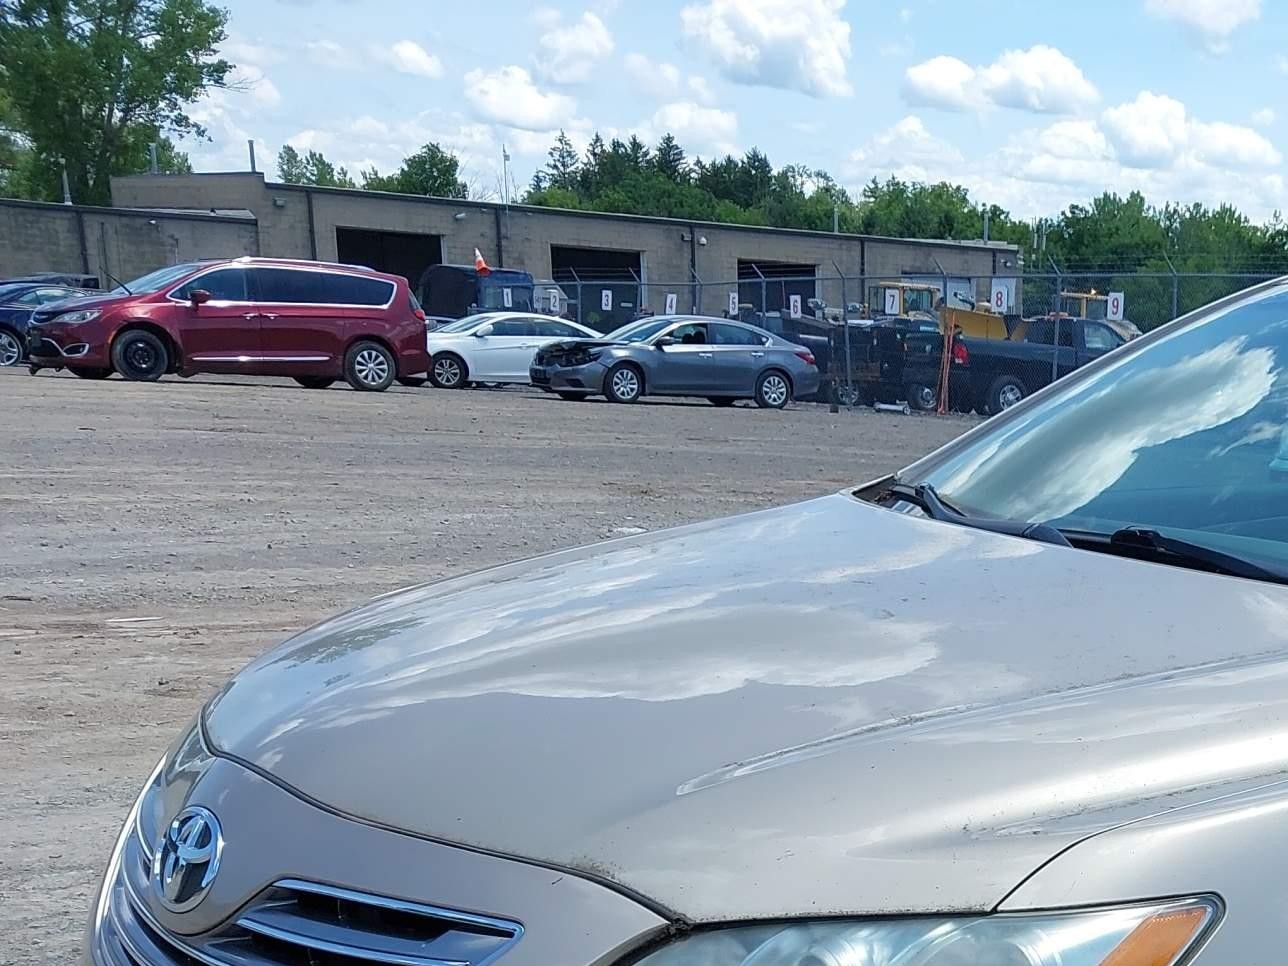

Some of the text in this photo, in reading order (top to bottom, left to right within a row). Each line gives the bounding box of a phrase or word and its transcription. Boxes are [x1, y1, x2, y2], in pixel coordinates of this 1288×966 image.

[792, 299, 799, 314] 6
[889, 294, 896, 310] 7
[995, 291, 1003, 308] 8
[1111, 297, 1120, 315] 9
